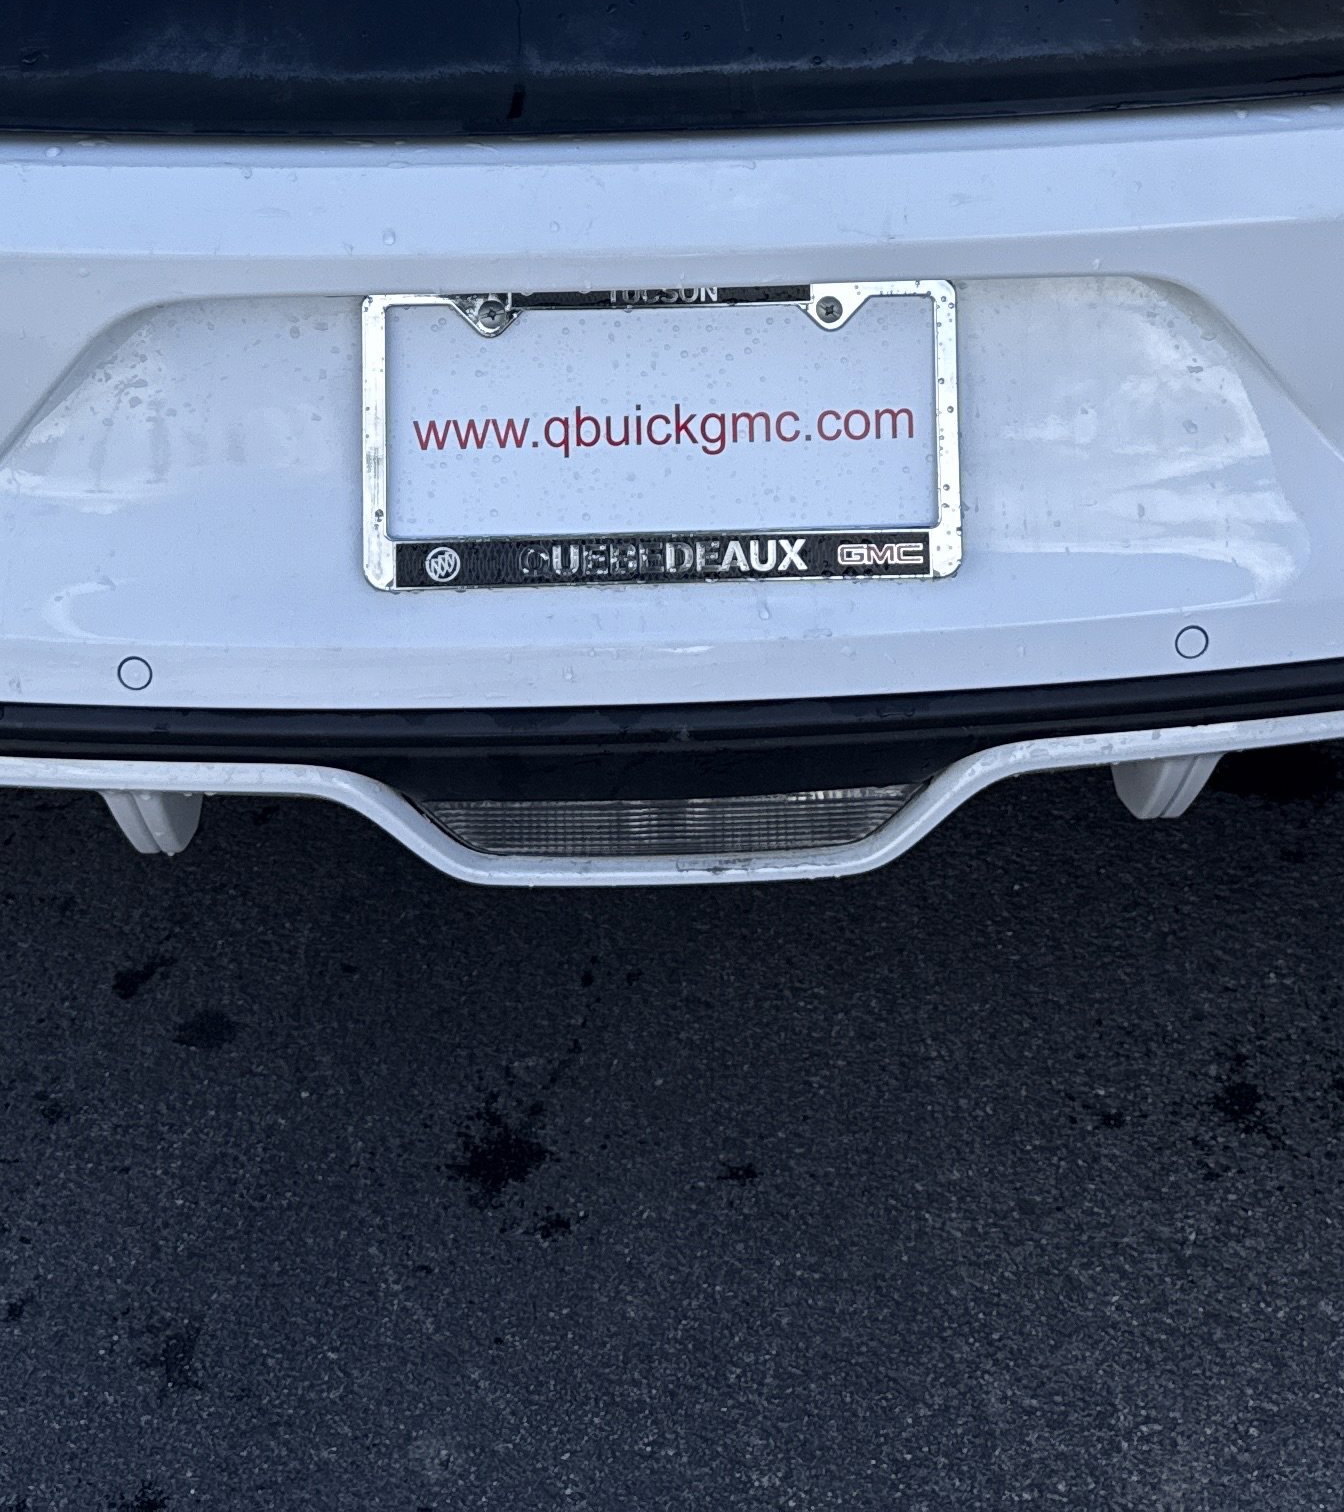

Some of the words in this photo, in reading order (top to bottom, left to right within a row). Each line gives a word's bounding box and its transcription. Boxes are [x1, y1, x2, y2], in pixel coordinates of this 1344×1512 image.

[413, 404, 915, 458] www.qbuickgmc.com
[519, 538, 809, 577] QUEBEDEAUX
[837, 543, 924, 566] GMC
